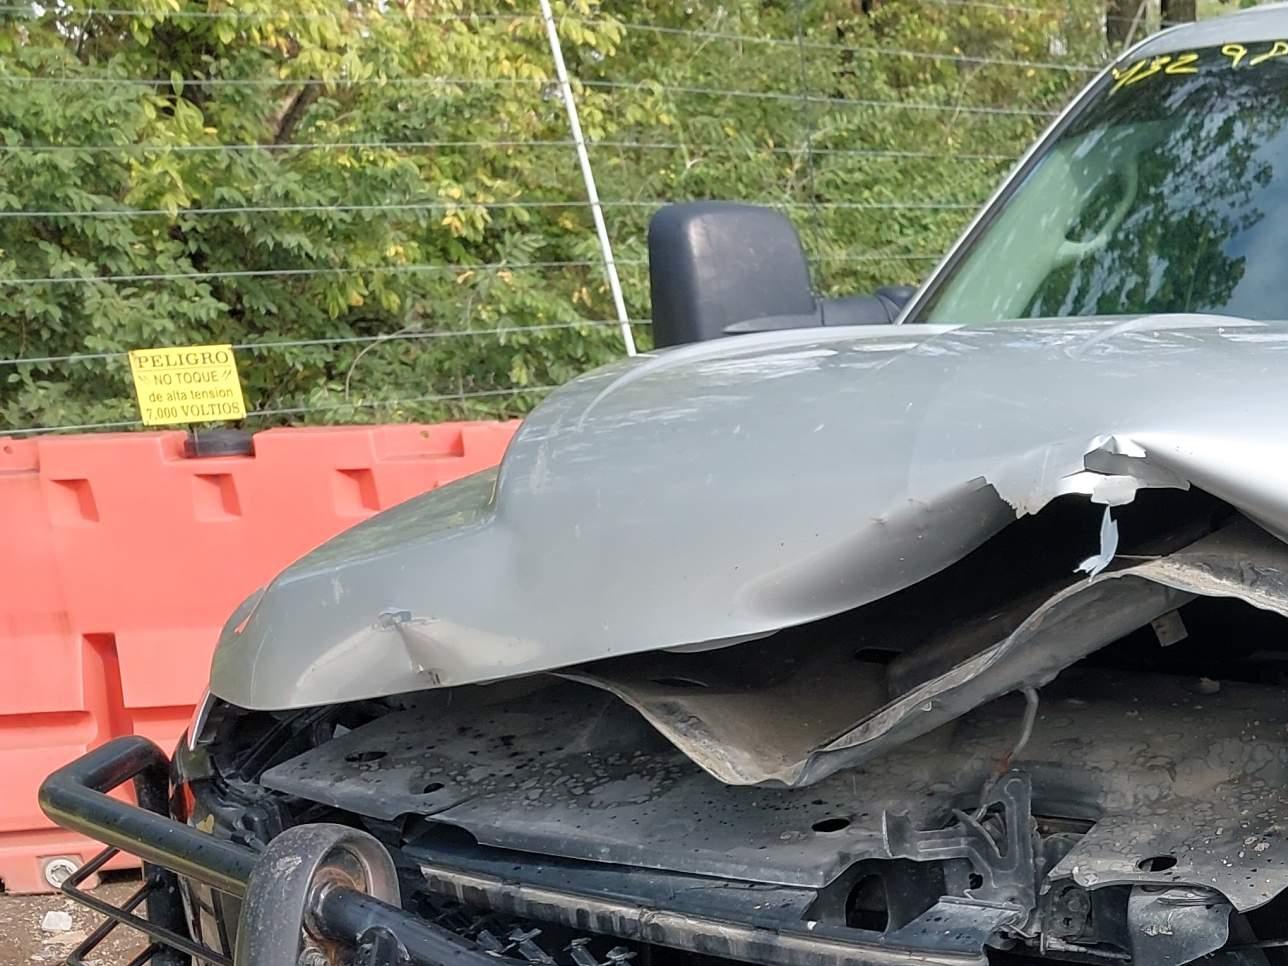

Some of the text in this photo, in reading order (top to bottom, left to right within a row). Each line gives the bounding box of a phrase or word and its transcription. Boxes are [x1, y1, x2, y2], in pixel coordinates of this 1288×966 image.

[137, 350, 229, 368] PELIGRO
[154, 370, 219, 385] NO TOQUE
[148, 391, 163, 403] de
[166, 389, 188, 401] alta
[181, 402, 240, 418] VOLTIOS
